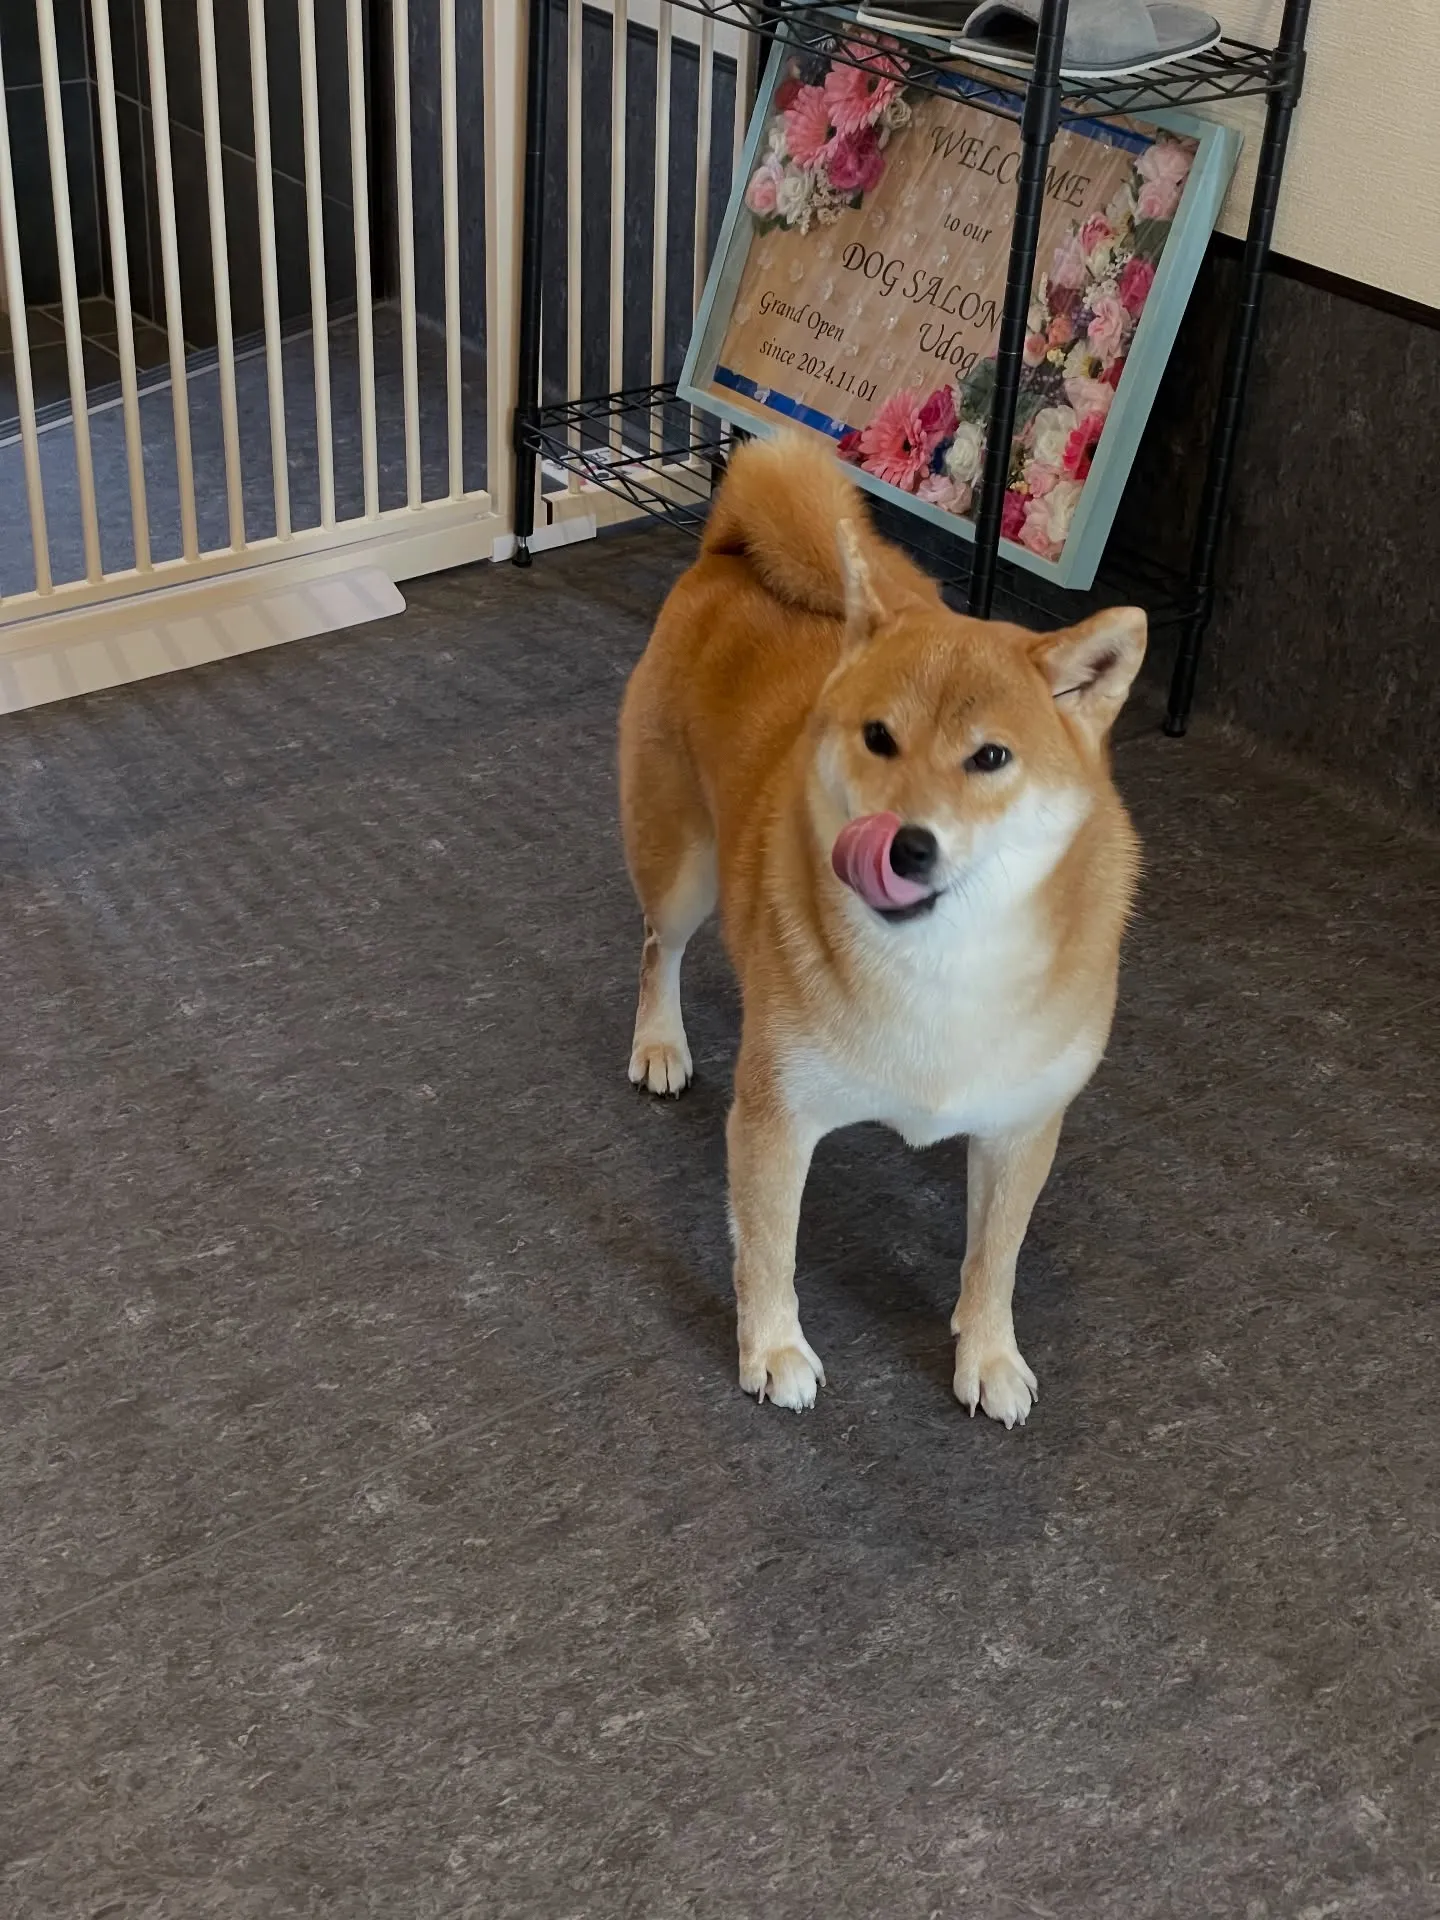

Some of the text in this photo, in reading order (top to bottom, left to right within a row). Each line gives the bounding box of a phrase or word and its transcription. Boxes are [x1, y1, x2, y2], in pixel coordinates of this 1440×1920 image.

[931, 126, 1090, 207] WELCME
[943, 214, 993, 243] to our
[759, 291, 845, 341] Grand Open
[842, 242, 1004, 333] DOG SALON
[759, 337, 878, 402] since 2024.11.01
[919, 323, 979, 380] Udog
